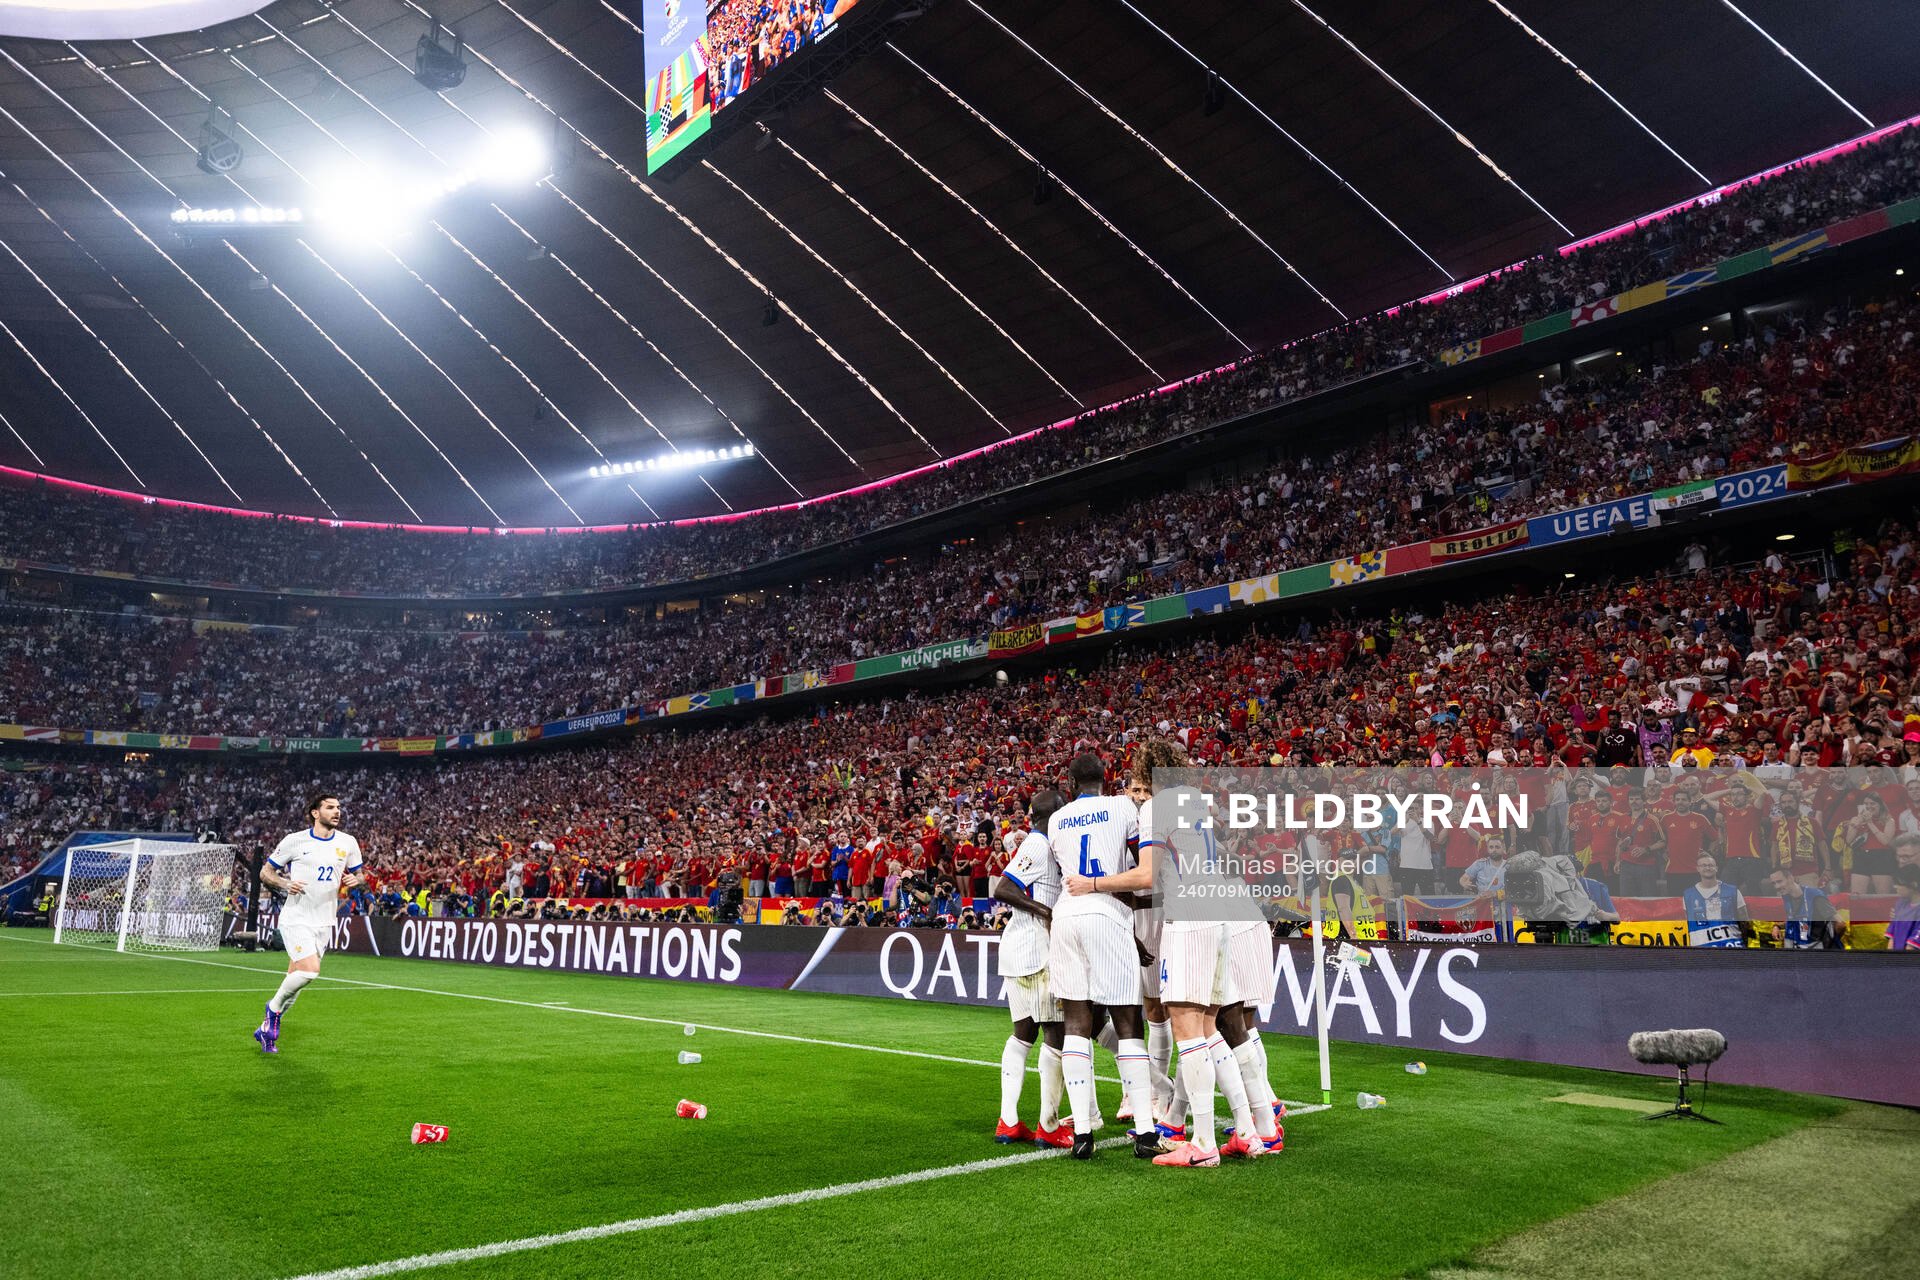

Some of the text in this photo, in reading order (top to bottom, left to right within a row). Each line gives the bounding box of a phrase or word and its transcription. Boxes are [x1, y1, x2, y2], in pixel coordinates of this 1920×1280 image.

[1553, 506, 1625, 536] UEFA
[1719, 470, 1788, 503] 2024
[286, 740, 321, 750] NICH
[1058, 810, 1109, 830] UPAMECANO
[1079, 834, 1105, 878] 4
[317, 866, 334, 882] 22
[1706, 926, 1730, 941] ICT
[401, 919, 742, 982] OVER 170 DESTINATIONS
[879, 931, 1487, 1044] QAT WAYS
